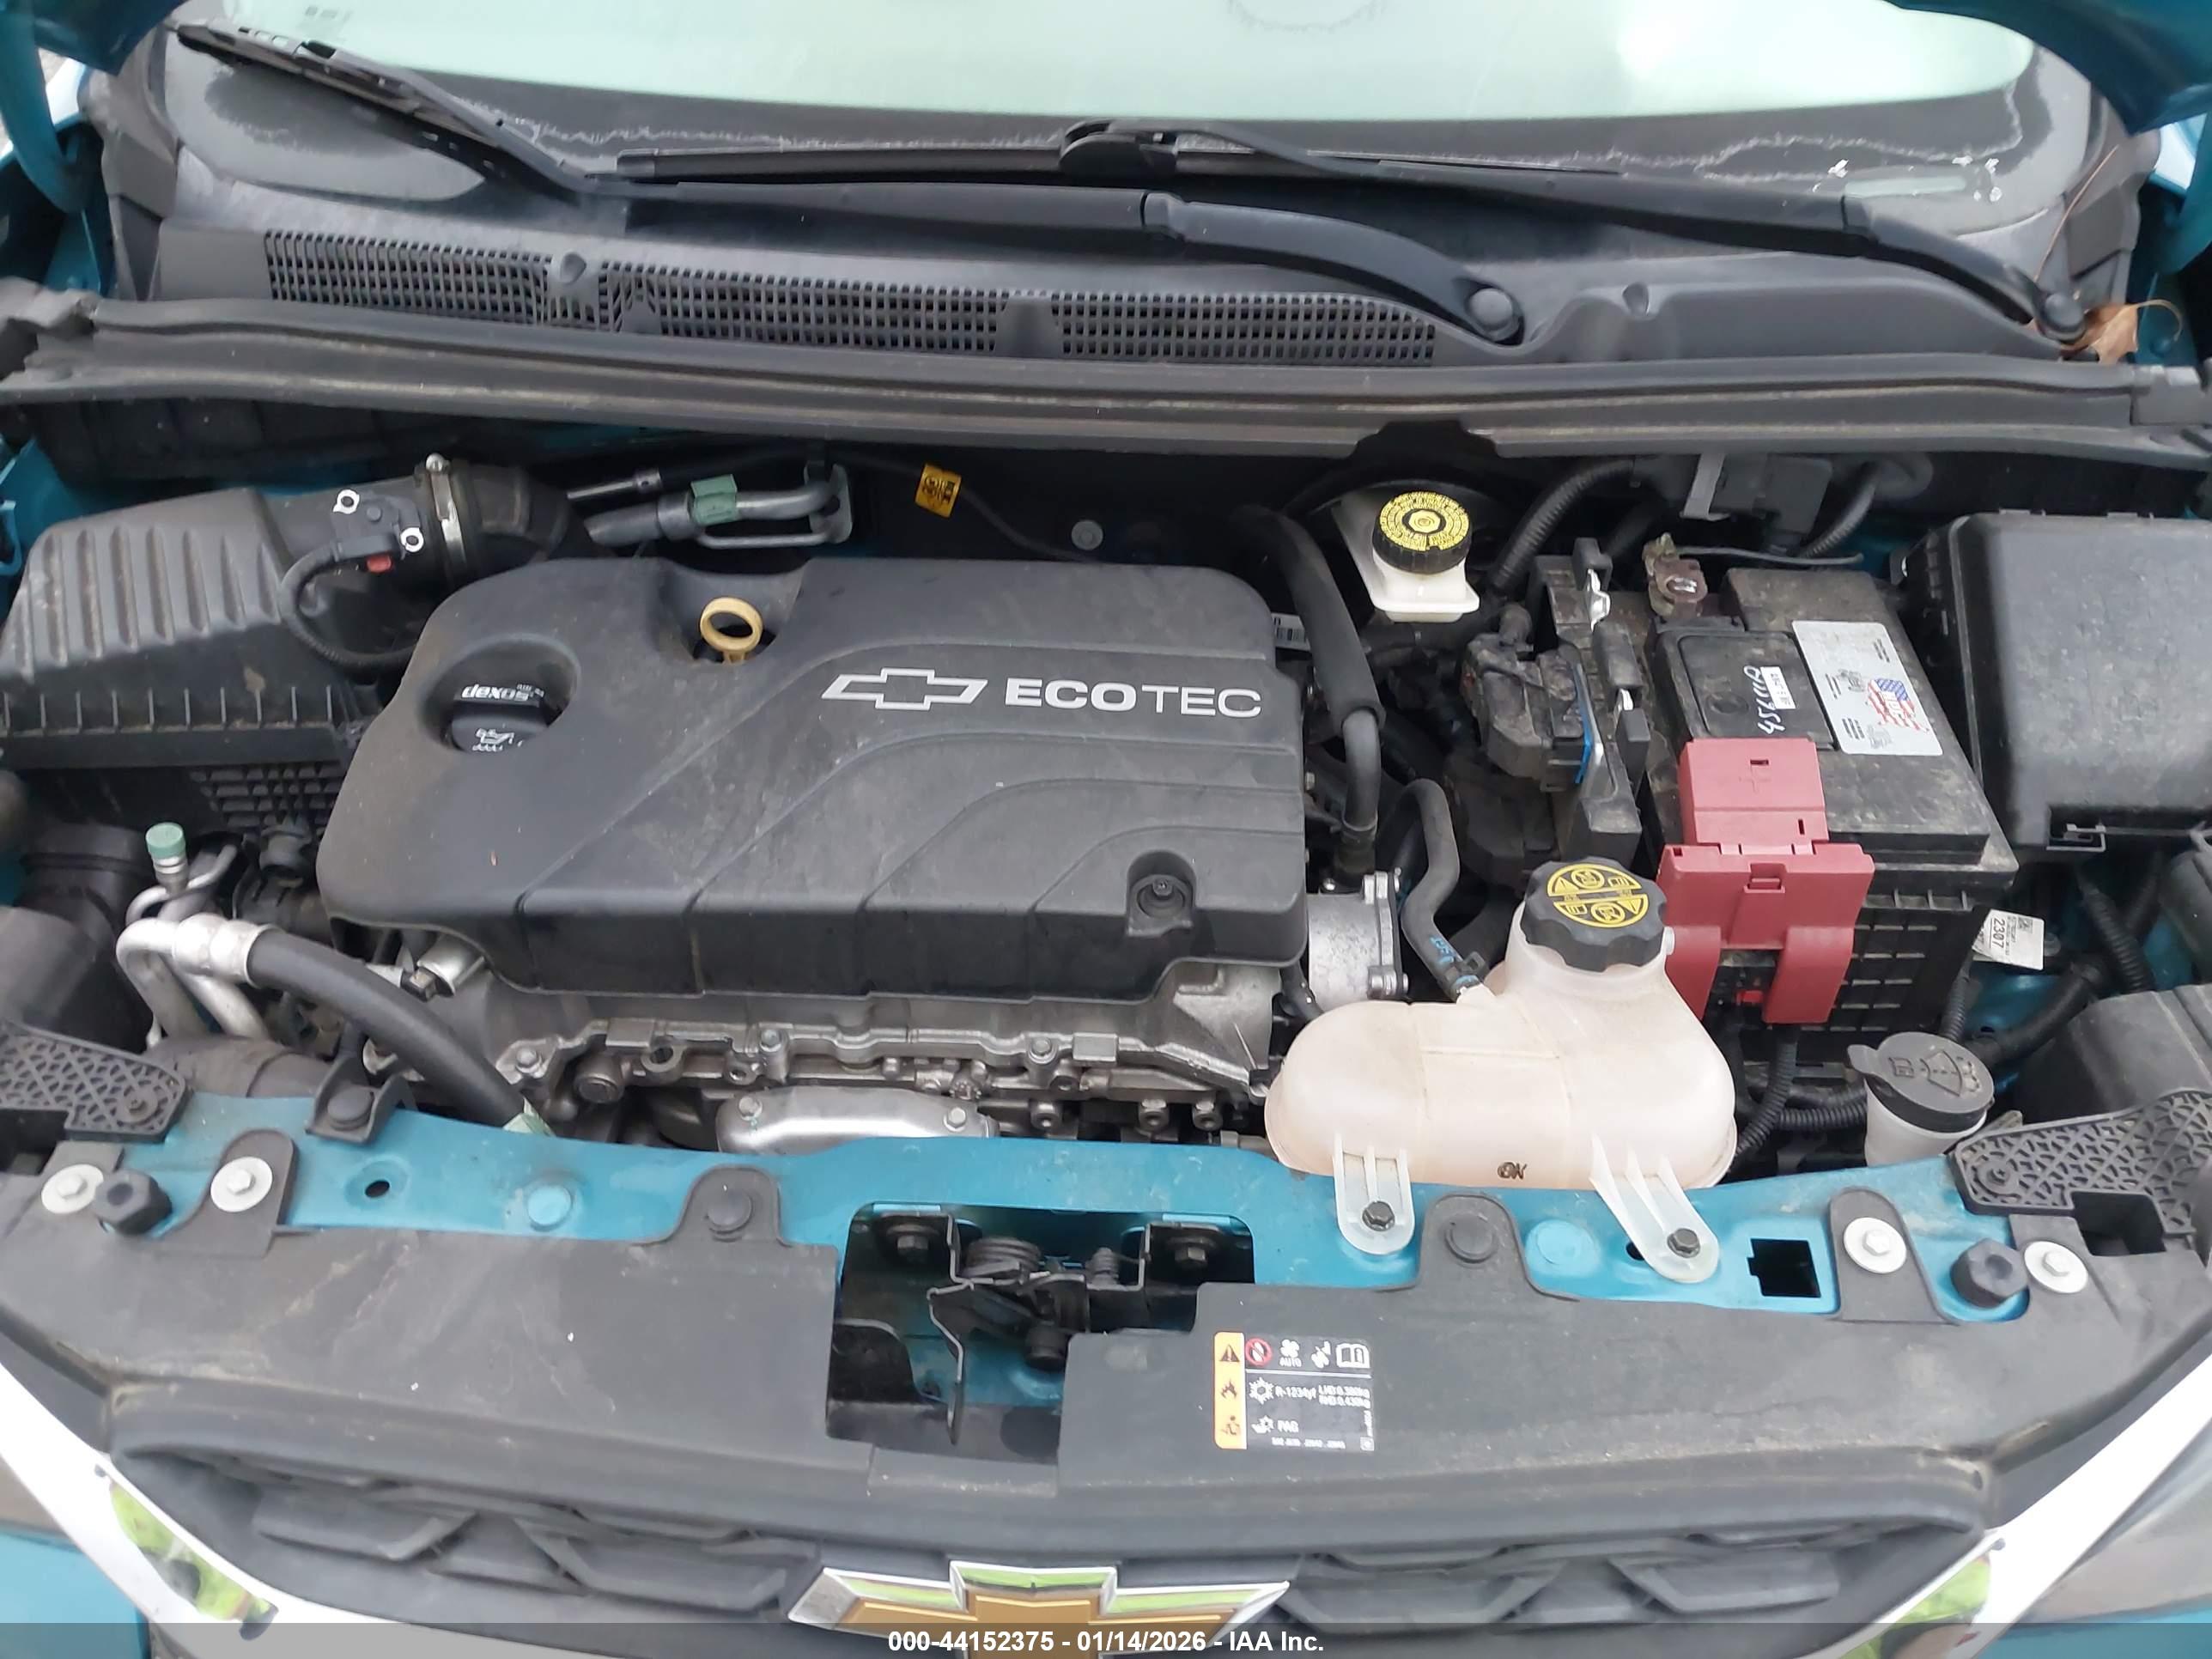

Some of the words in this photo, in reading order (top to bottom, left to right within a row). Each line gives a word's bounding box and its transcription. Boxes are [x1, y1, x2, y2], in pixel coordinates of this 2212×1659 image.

[462, 684, 529, 702] dexos
[1005, 678, 1261, 718] ECOTEC
[1992, 917, 2006, 949] 2307
